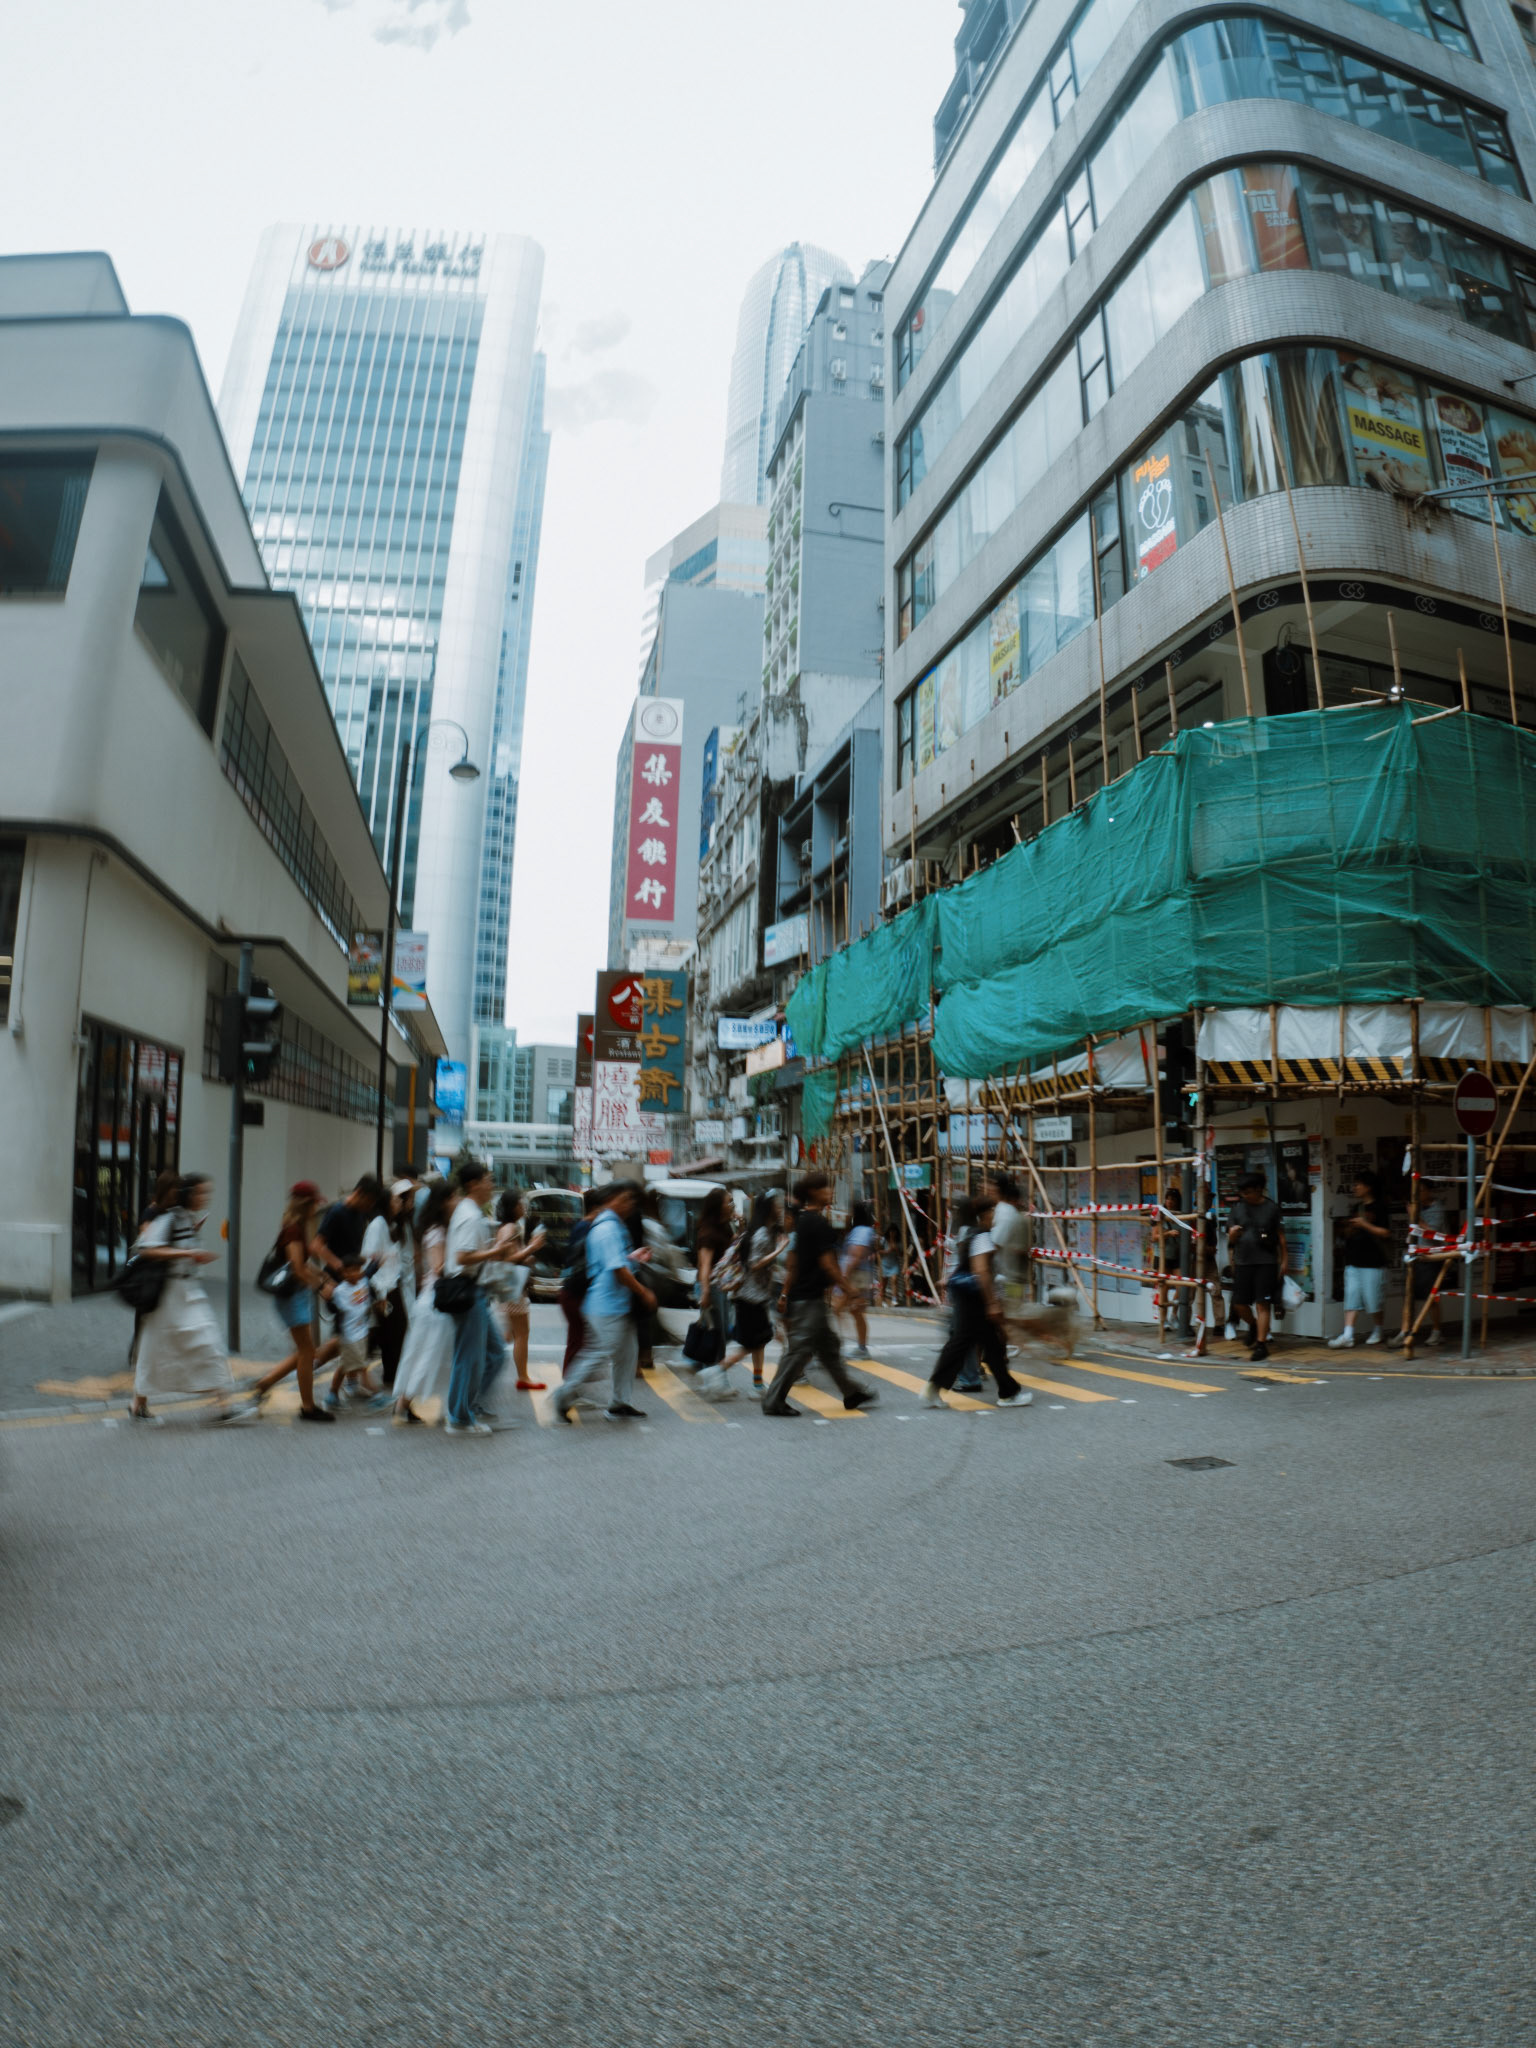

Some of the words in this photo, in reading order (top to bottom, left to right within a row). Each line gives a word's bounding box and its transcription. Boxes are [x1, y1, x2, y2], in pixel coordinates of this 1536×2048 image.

[1353, 414, 1422, 449] MASSAGE
[993, 635, 1017, 667] MASSAGE
[634, 752, 673, 910] 集友銀行
[633, 977, 683, 1107] 集古齋
